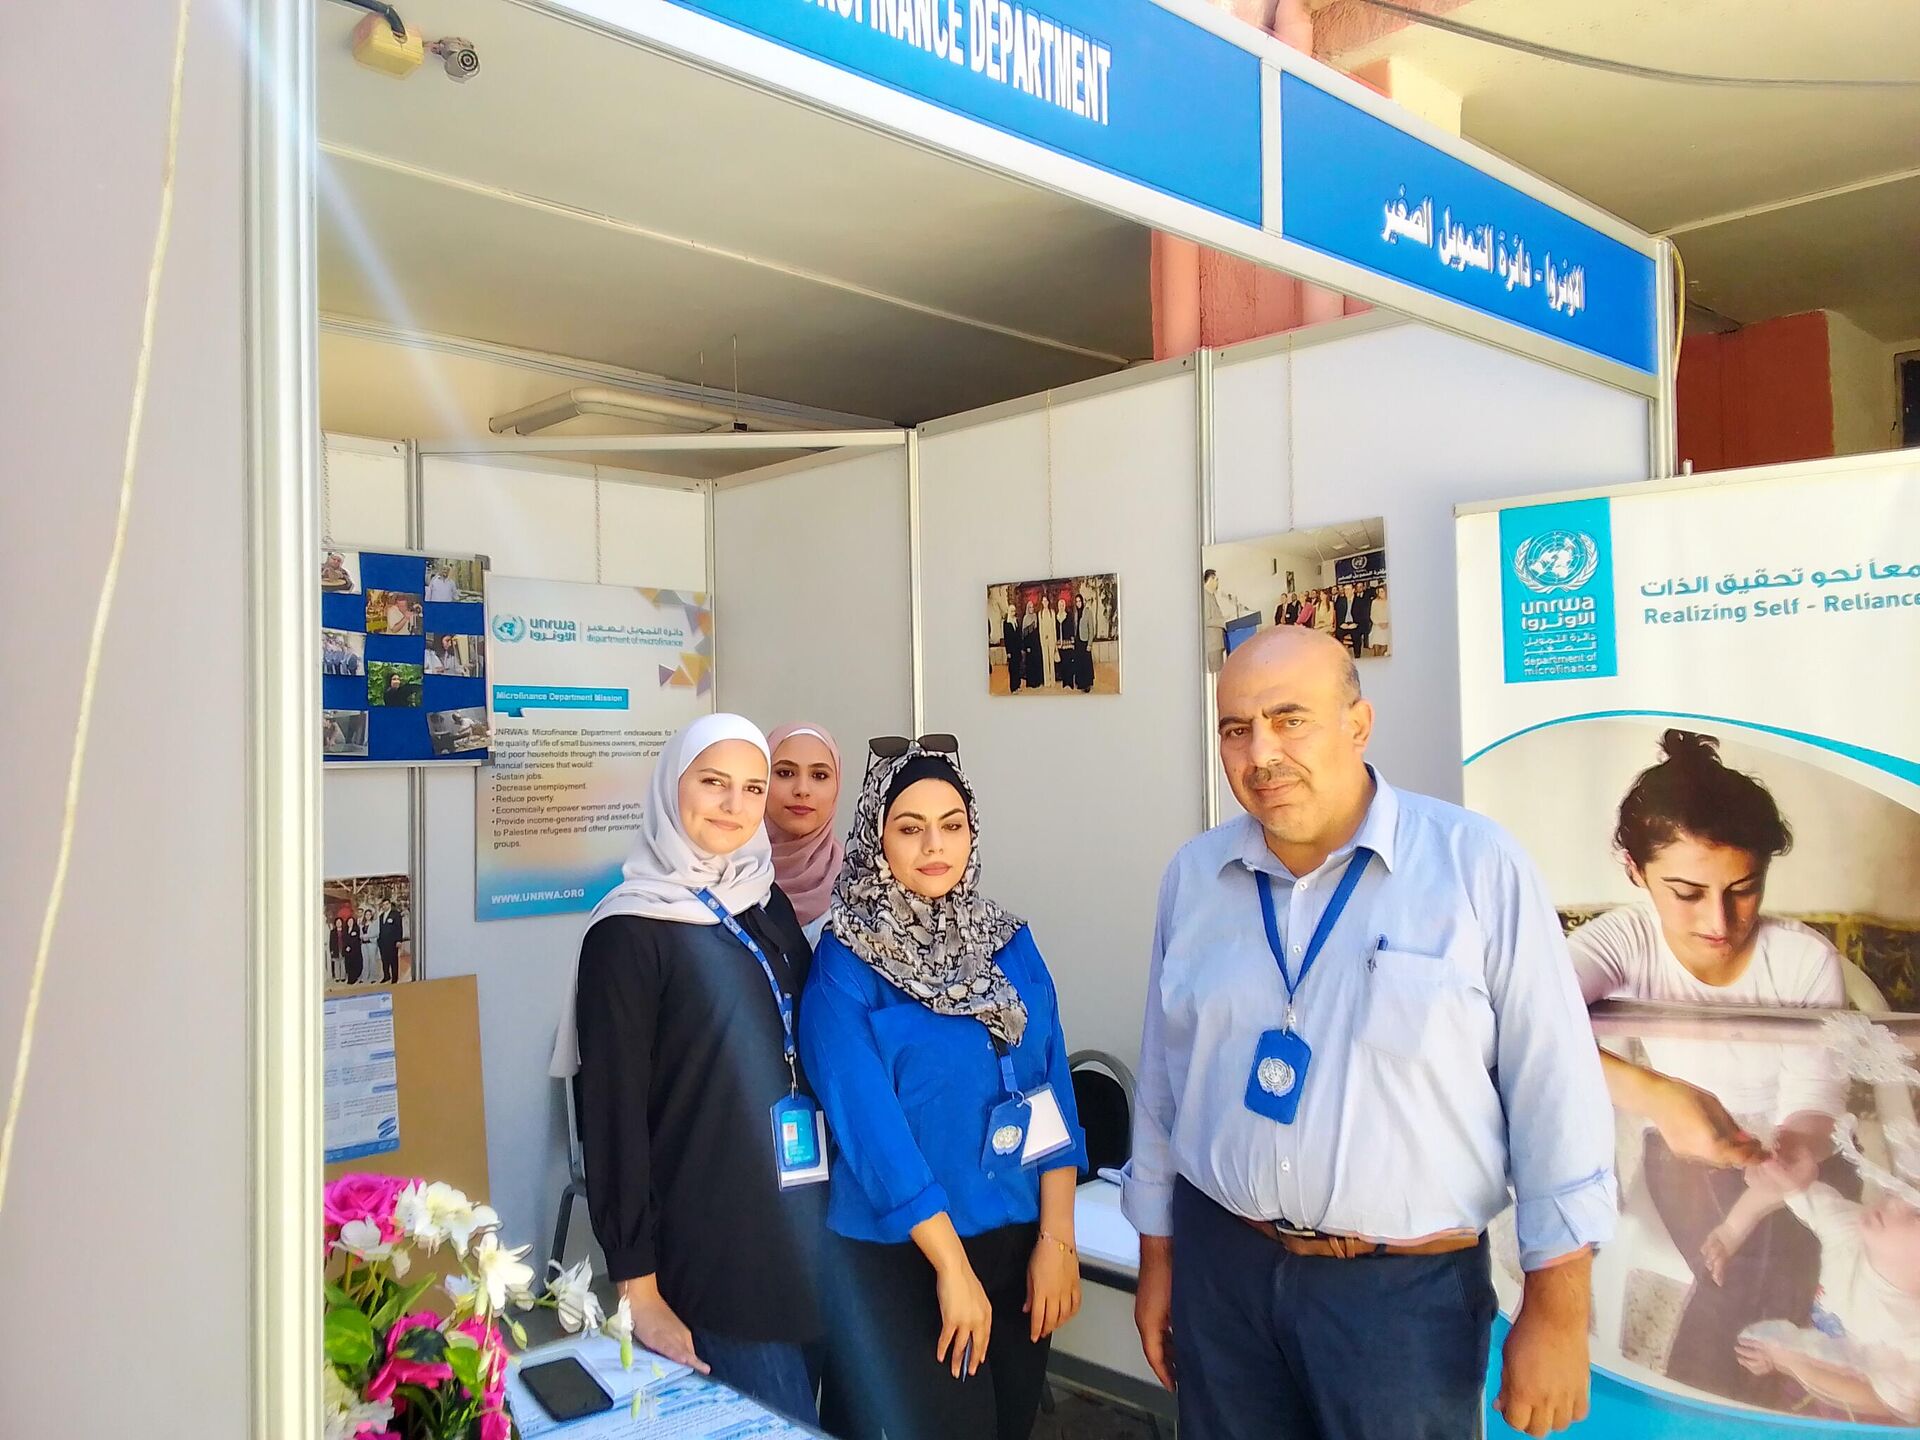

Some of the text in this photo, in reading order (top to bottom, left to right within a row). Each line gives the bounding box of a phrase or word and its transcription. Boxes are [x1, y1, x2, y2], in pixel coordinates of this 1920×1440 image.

[970, 0, 1111, 126] DEPARTMENT
[1381, 184, 1433, 248] الصغير
[1439, 206, 1495, 274] التمويل
[1499, 231, 1532, 291] دائرة
[1715, 568, 1803, 596] تحقيق
[1811, 563, 1862, 588] نحو
[1640, 575, 1709, 597] الذات
[1521, 596, 1594, 615] unrwa
[1644, 604, 1748, 625] Realizing
[1754, 598, 1800, 618] Self
[530, 618, 576, 631] unrwa
[1521, 612, 1596, 632] الاونروا
[1524, 652, 1596, 666] department of
[1524, 664, 1598, 676] microfinance
[496, 692, 622, 702] Microfinance Department Mission
[532, 728, 578, 736] Microfinance
[580, 729, 621, 738] Department
[506, 740, 530, 748] quality
[570, 750, 597, 759] through
[496, 772, 524, 780] Sustain
[496, 806, 544, 814] Economically
[546, 805, 579, 813] empower
[503, 828, 538, 836] Palestine
[540, 826, 572, 836] refugees
[574, 825, 587, 833] and
[588, 824, 607, 832] other
[491, 888, 584, 904] WWW.UNRWA.ORG
